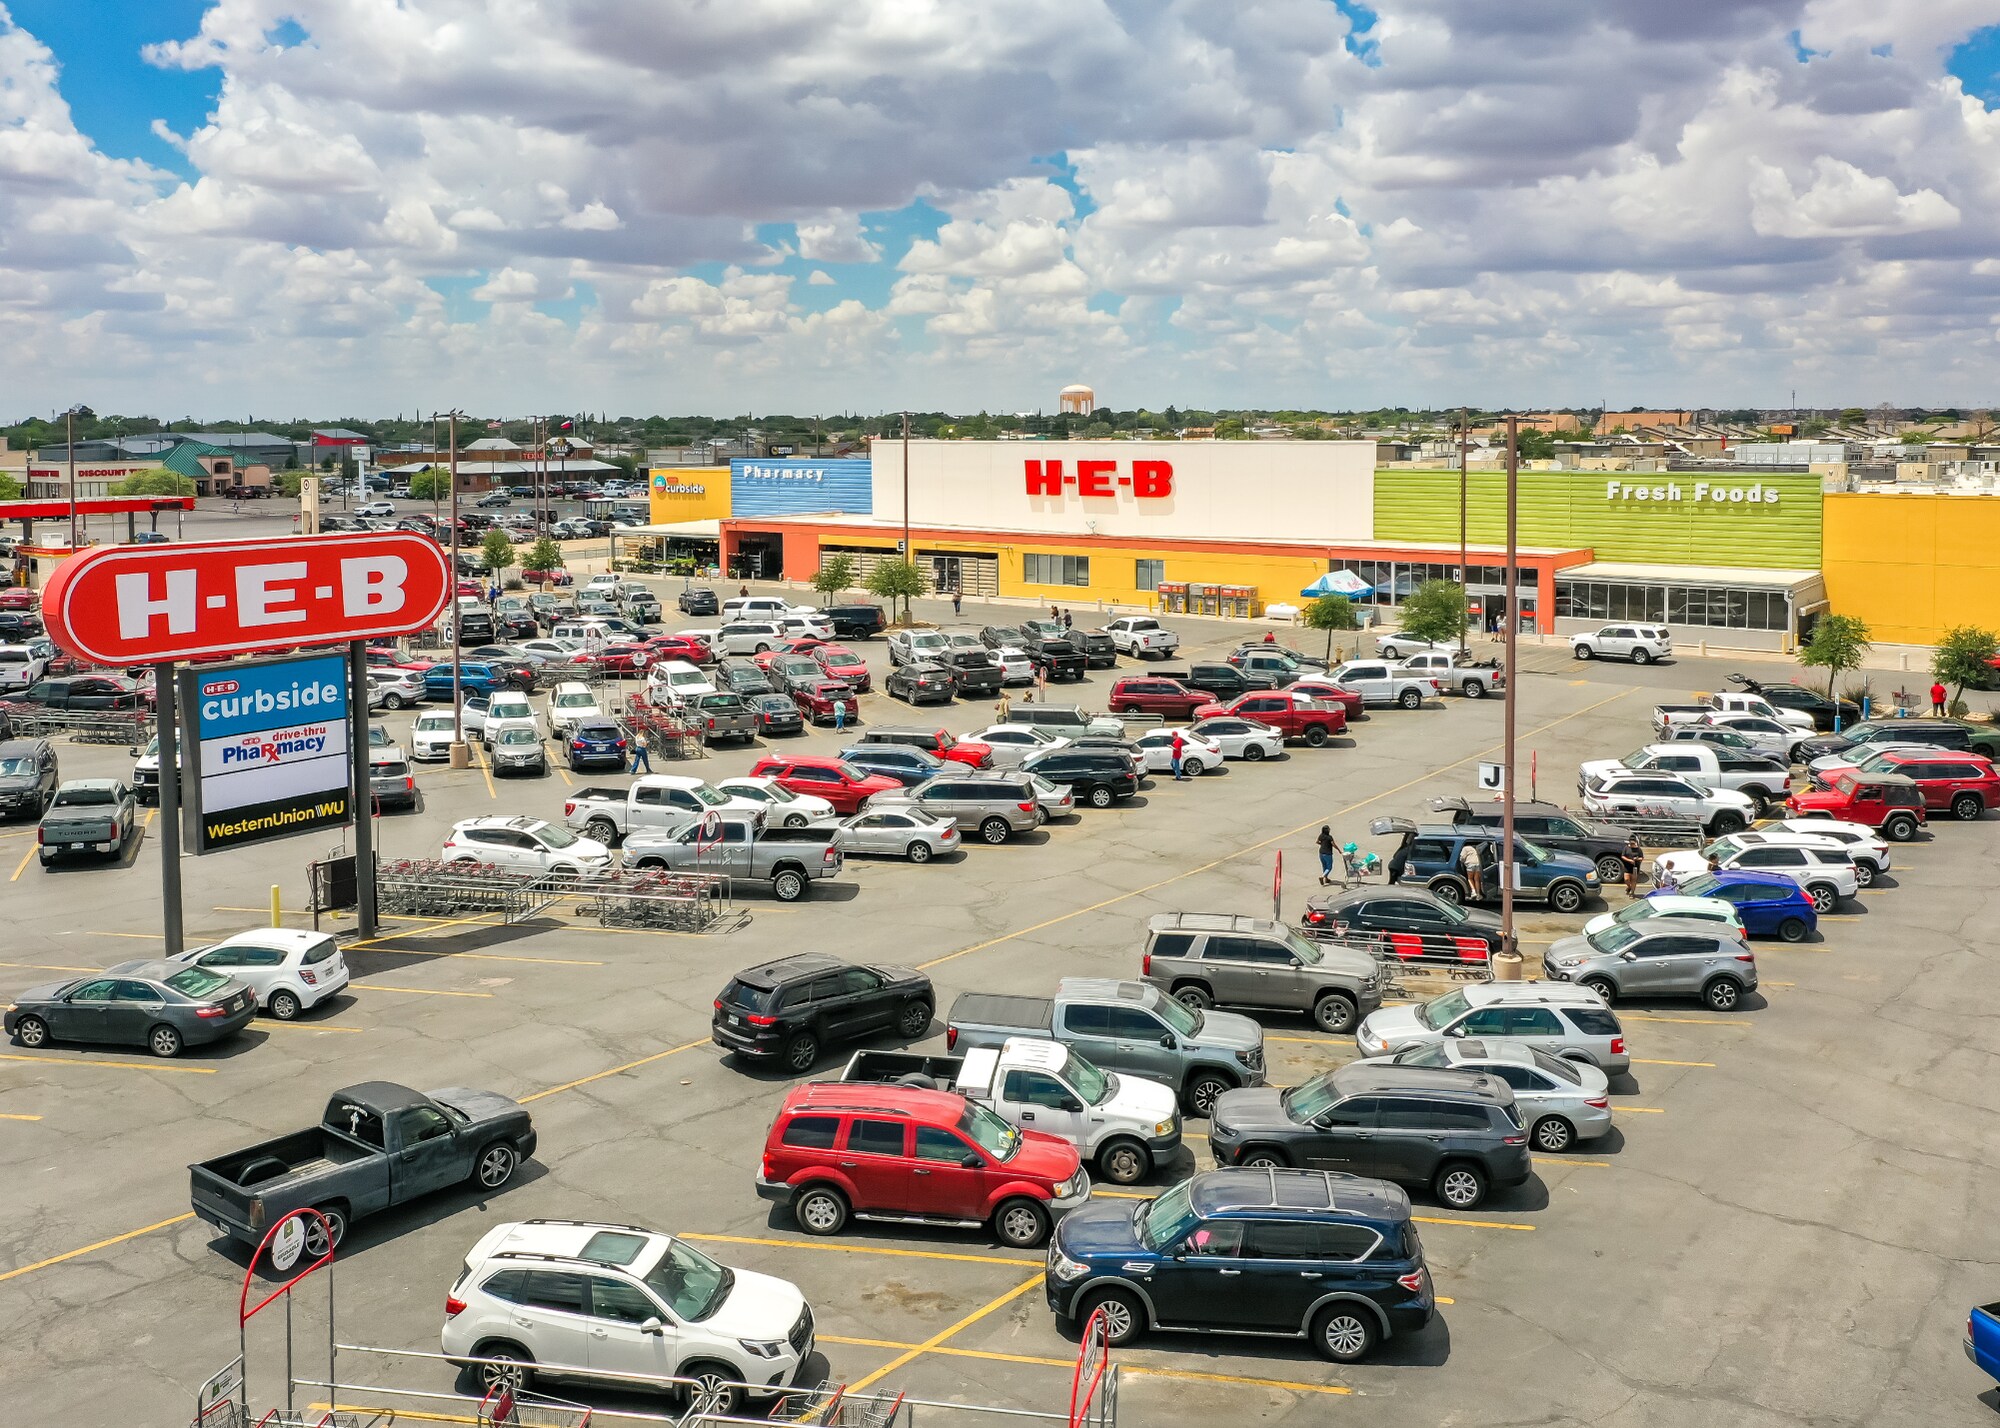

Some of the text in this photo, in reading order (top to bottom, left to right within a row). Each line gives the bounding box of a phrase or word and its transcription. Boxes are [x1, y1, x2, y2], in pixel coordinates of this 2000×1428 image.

[78, 469, 127, 477] DISCOUNT
[743, 465, 824, 481] Pharmacy
[1024, 460, 1174, 497] H-E-B
[665, 482, 705, 494] curbside
[1607, 481, 1779, 504] Fresh Foods
[115, 555, 408, 640] H-E-B
[445, 627, 453, 641] G
[206, 683, 236, 694] H-E-B
[202, 681, 338, 721] curbside
[272, 726, 327, 742] drive-thru
[1484, 766, 1500, 787] J
[58, 829, 98, 837] TUNDRA
